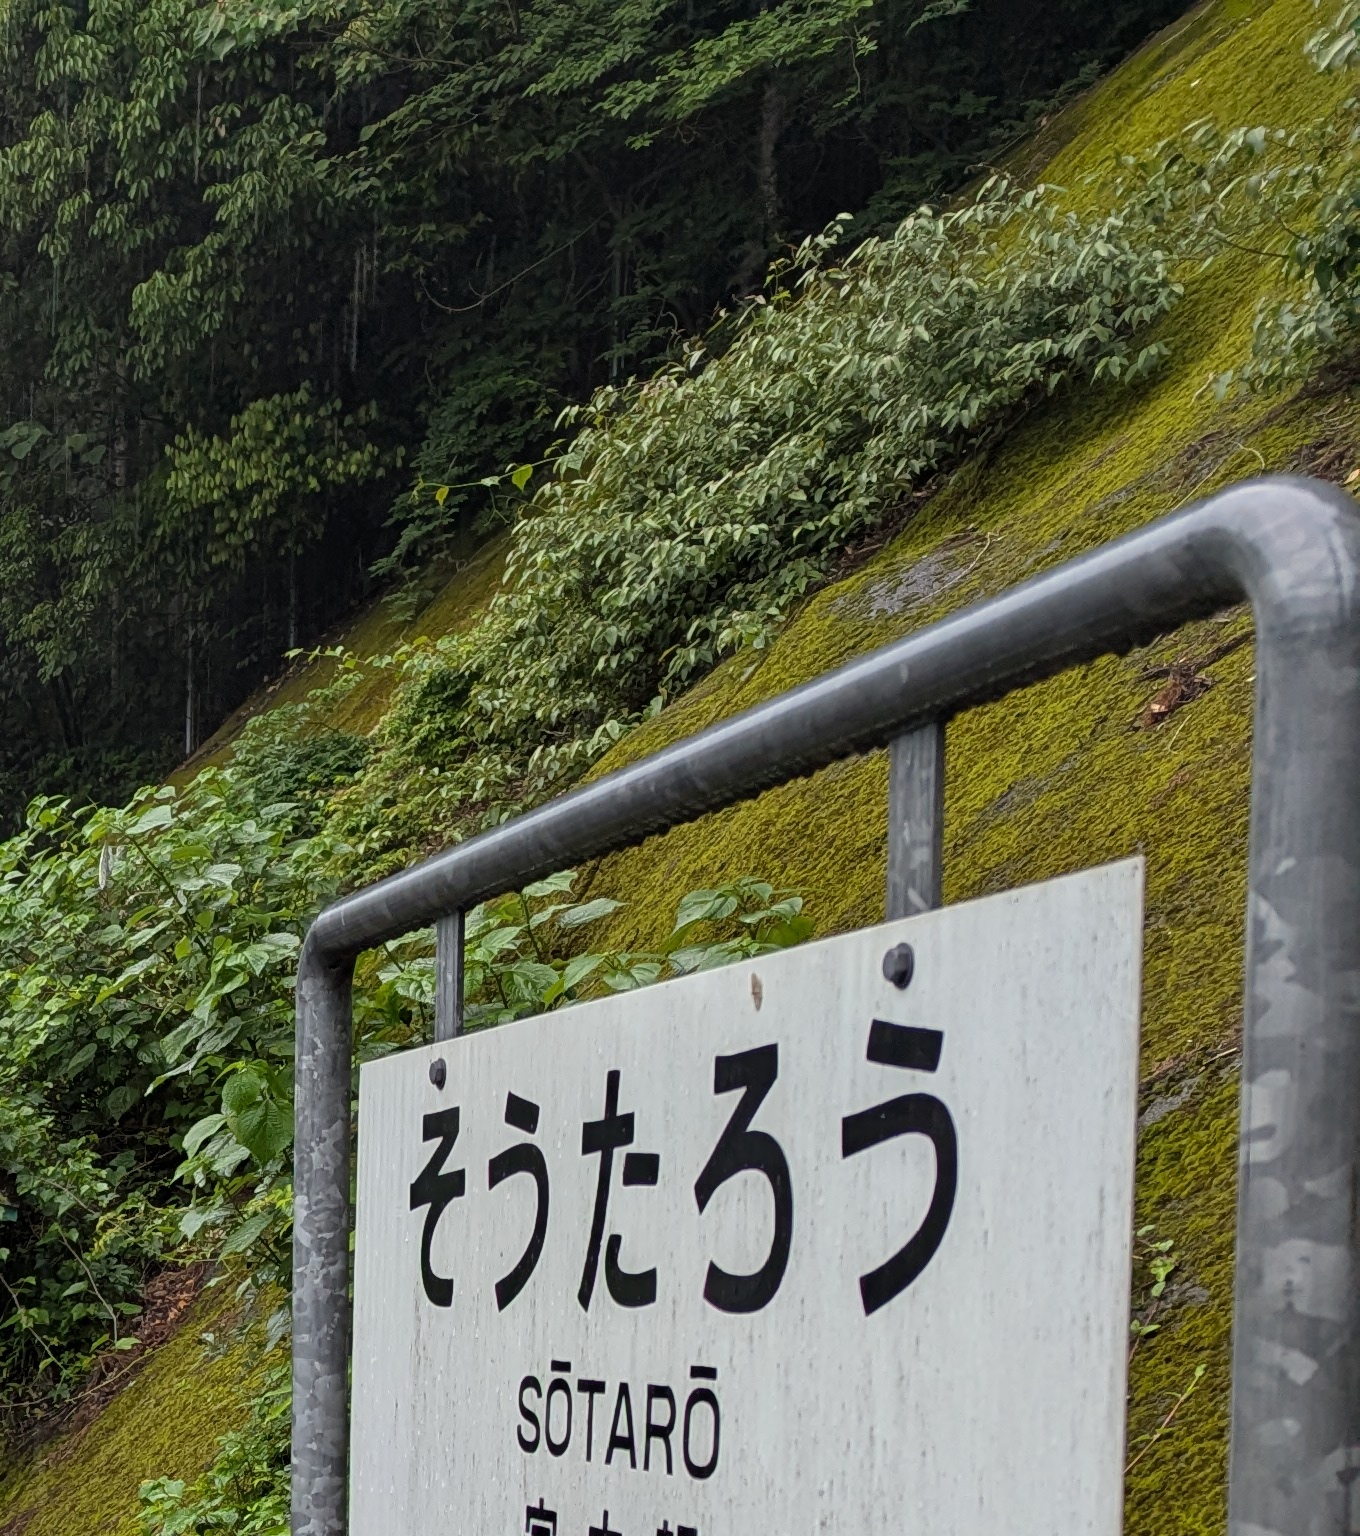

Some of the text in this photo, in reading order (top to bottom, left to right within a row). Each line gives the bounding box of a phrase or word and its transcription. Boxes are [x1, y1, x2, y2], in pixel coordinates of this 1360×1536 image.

[408, 1017, 959, 1318] そうたろう
[516, 1359, 722, 1481] SŌTARŌ
